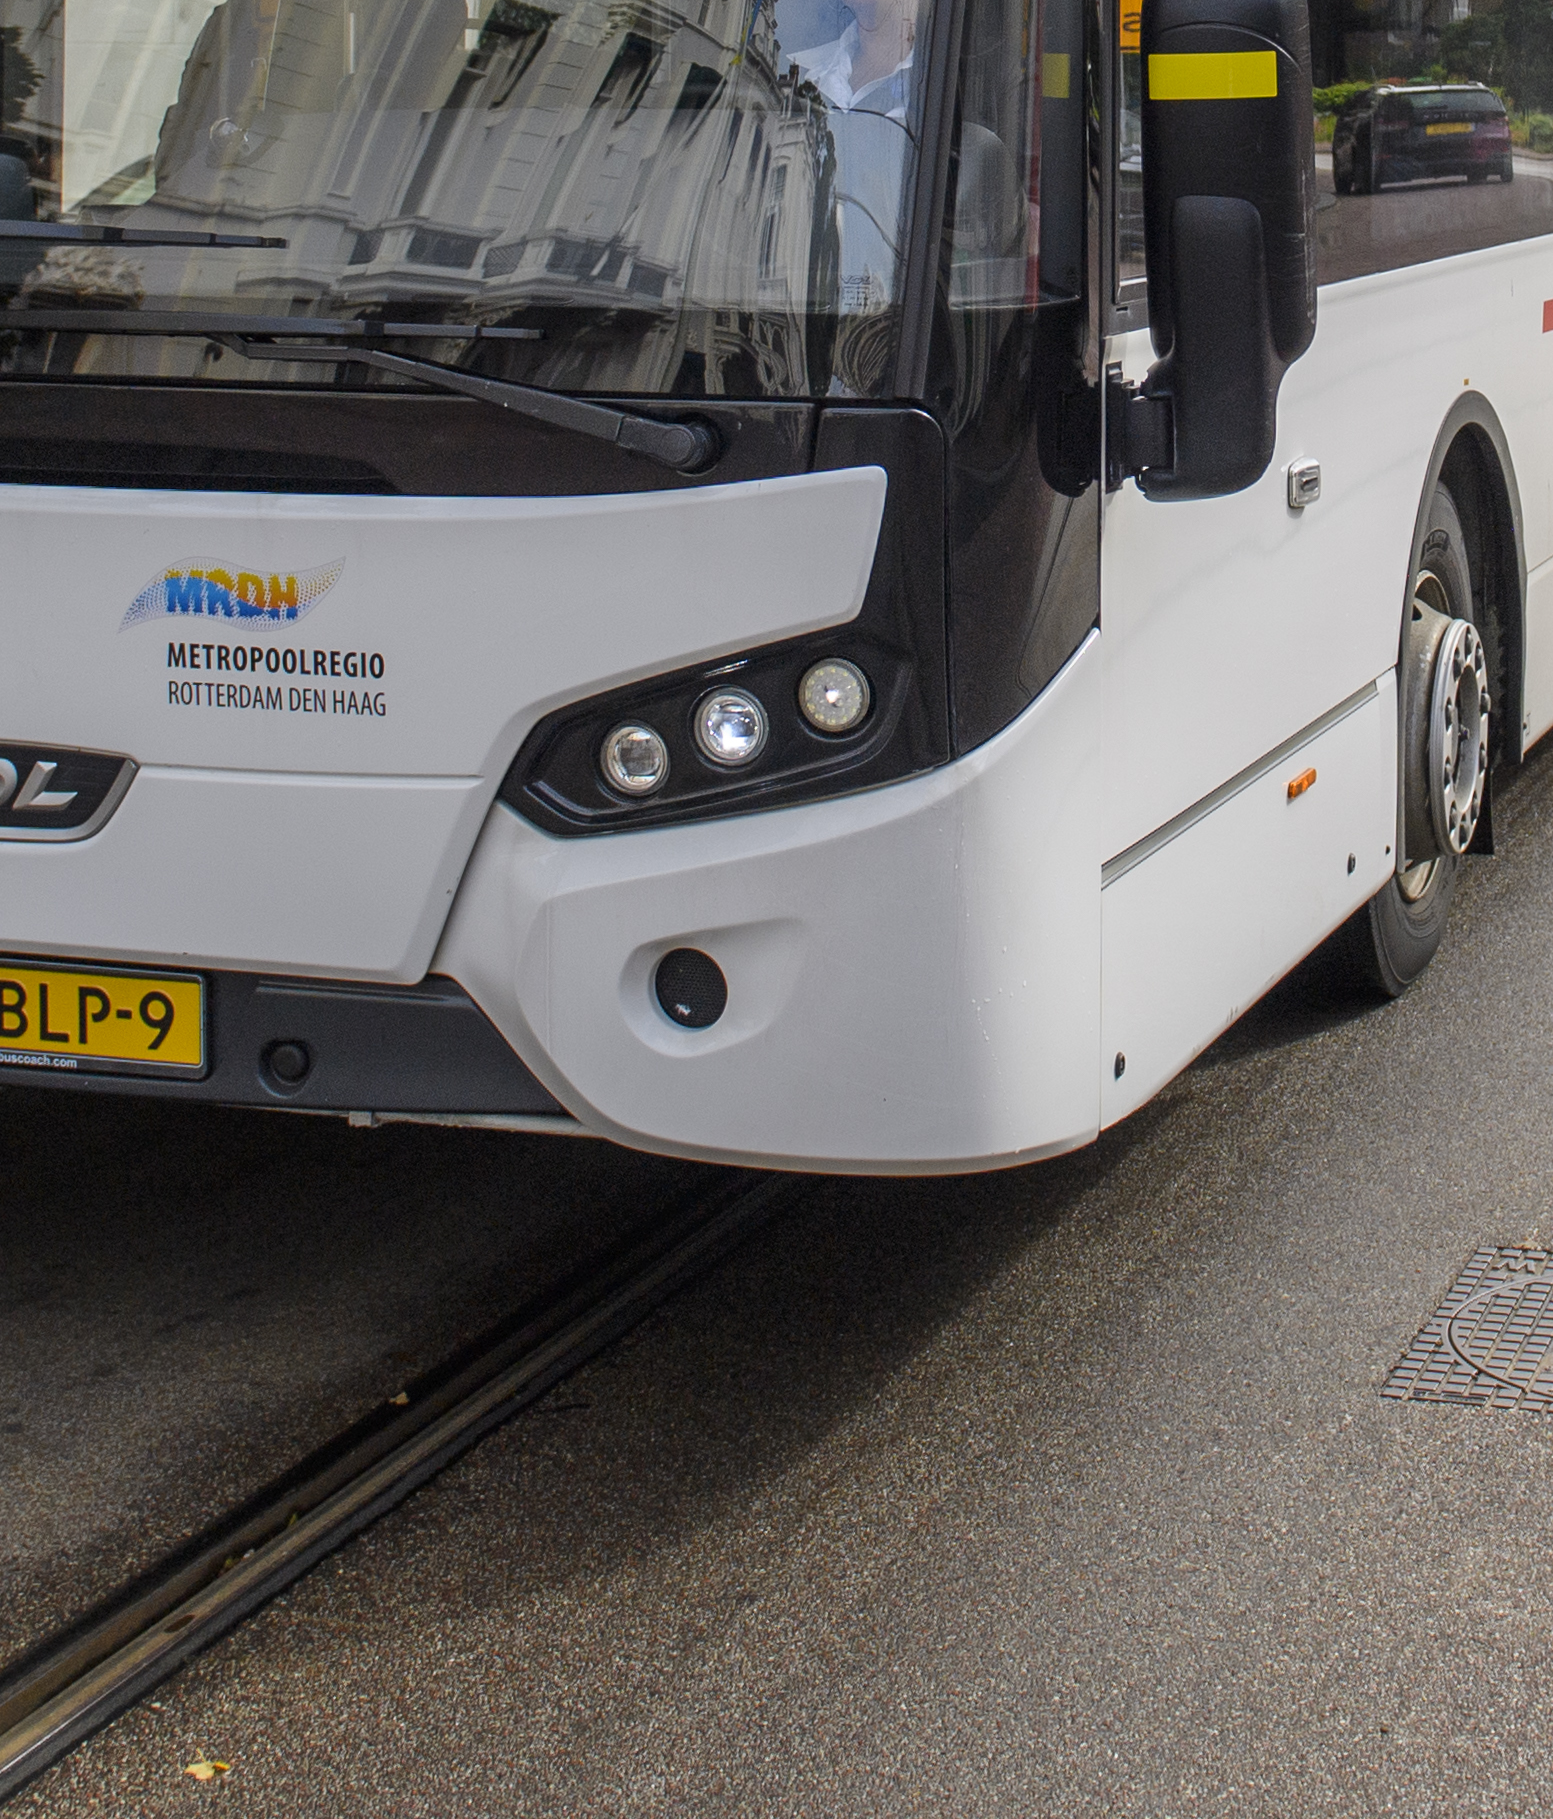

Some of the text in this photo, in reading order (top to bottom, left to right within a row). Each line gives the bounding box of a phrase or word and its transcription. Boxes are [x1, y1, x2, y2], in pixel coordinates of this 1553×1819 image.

[164, 568, 299, 620] MRDH
[167, 641, 386, 679] METROPOOLREGIO
[168, 680, 387, 717] ROTTERDAM DEN HAAG
